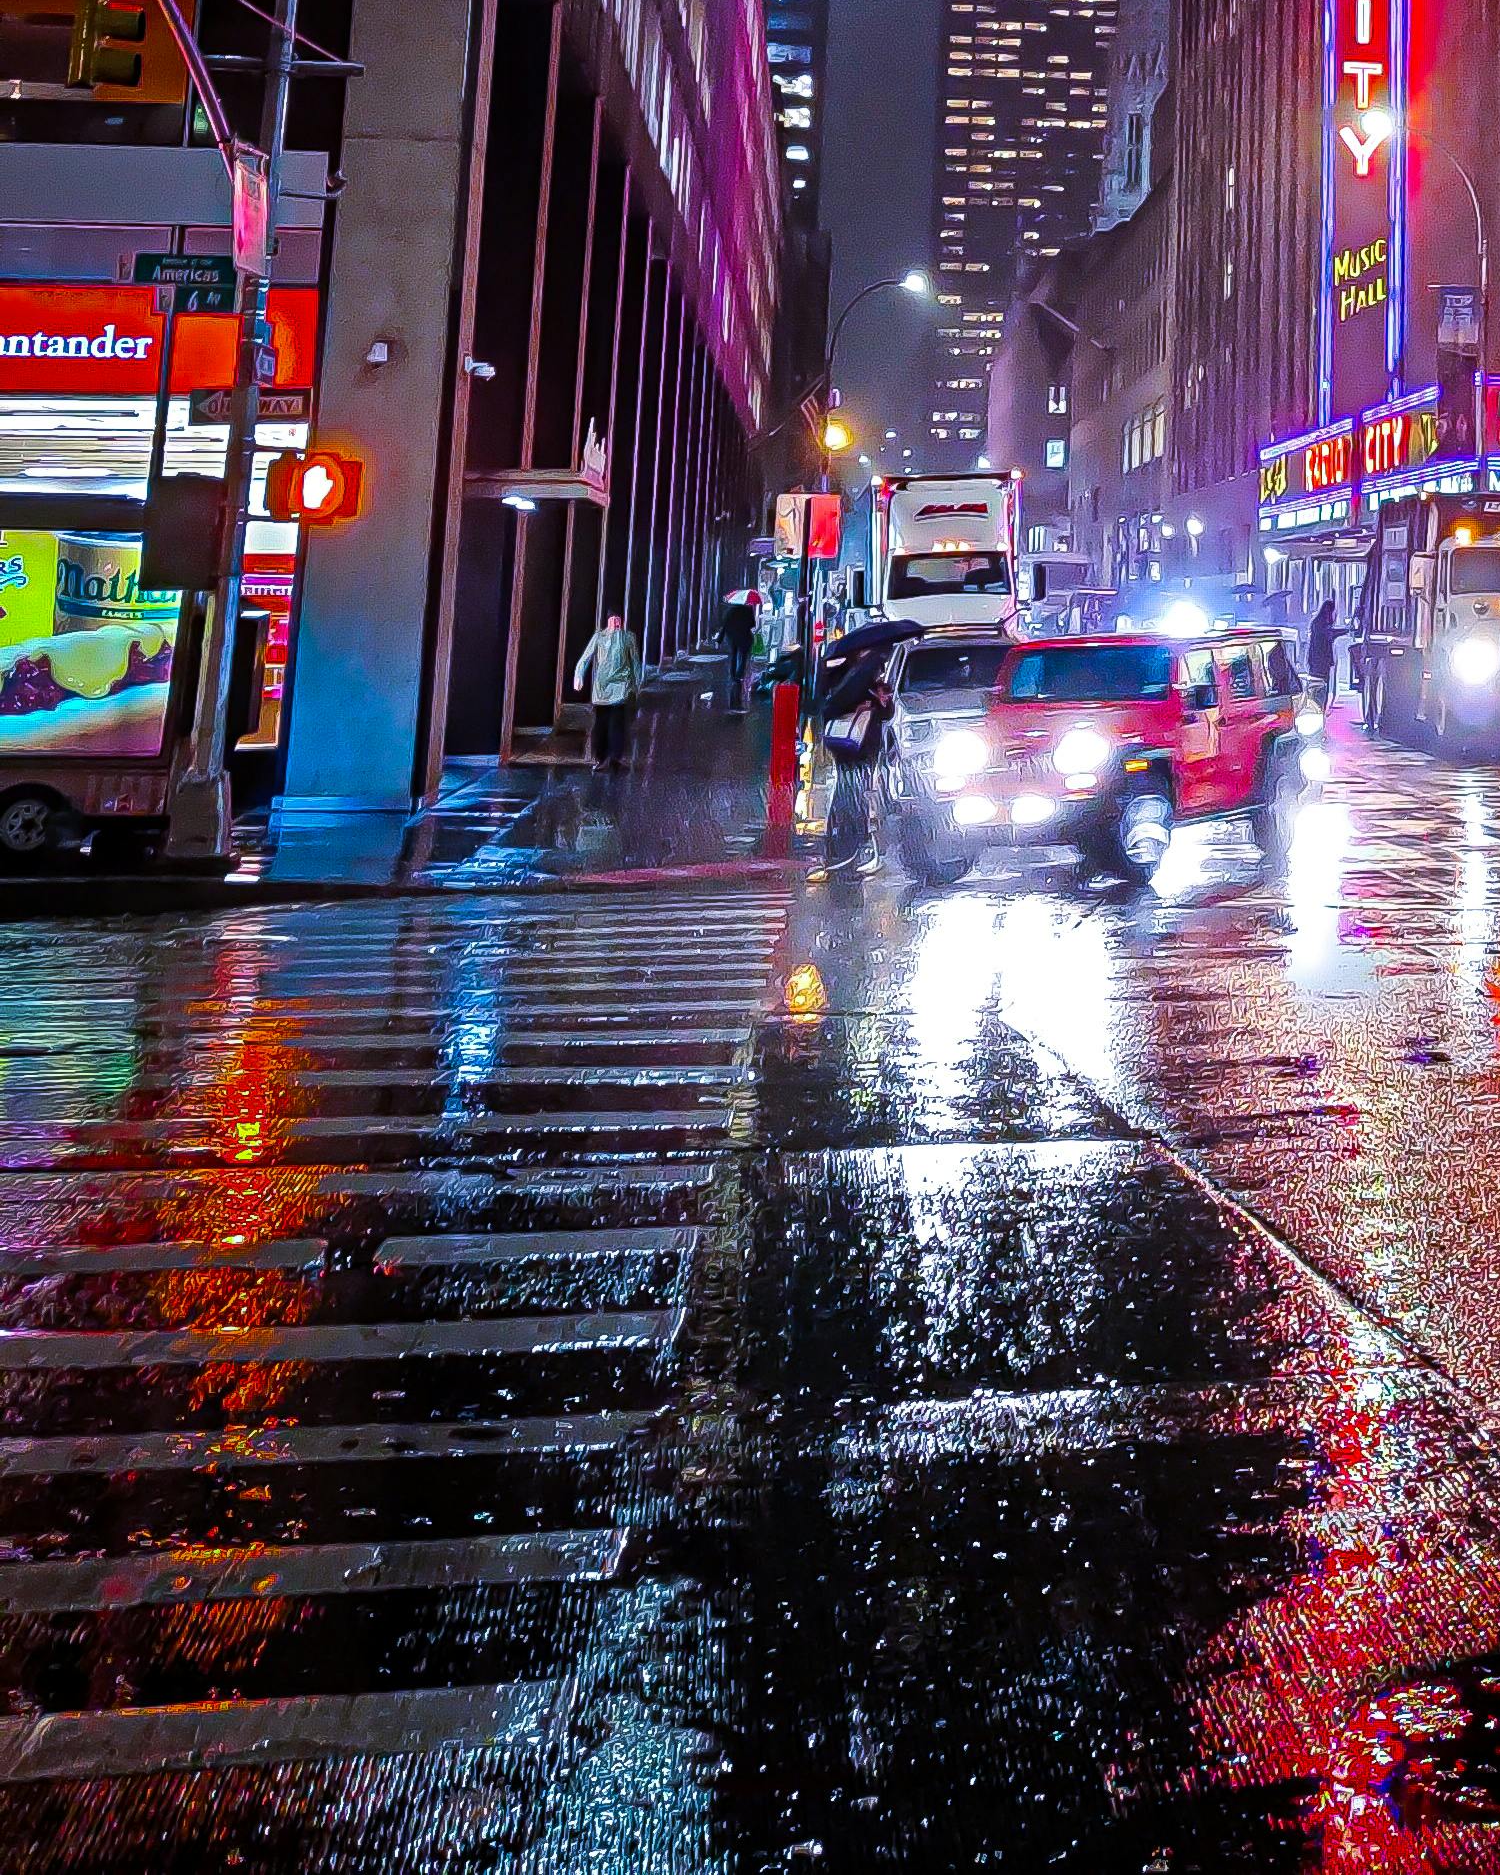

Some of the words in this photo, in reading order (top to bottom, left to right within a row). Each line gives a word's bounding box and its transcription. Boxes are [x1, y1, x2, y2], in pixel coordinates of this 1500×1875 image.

[152, 265, 219, 283] Americas
[1333, 238, 1387, 287] MUSIC
[1339, 278, 1387, 323] HALL
[1364, 415, 1402, 474] CITY
